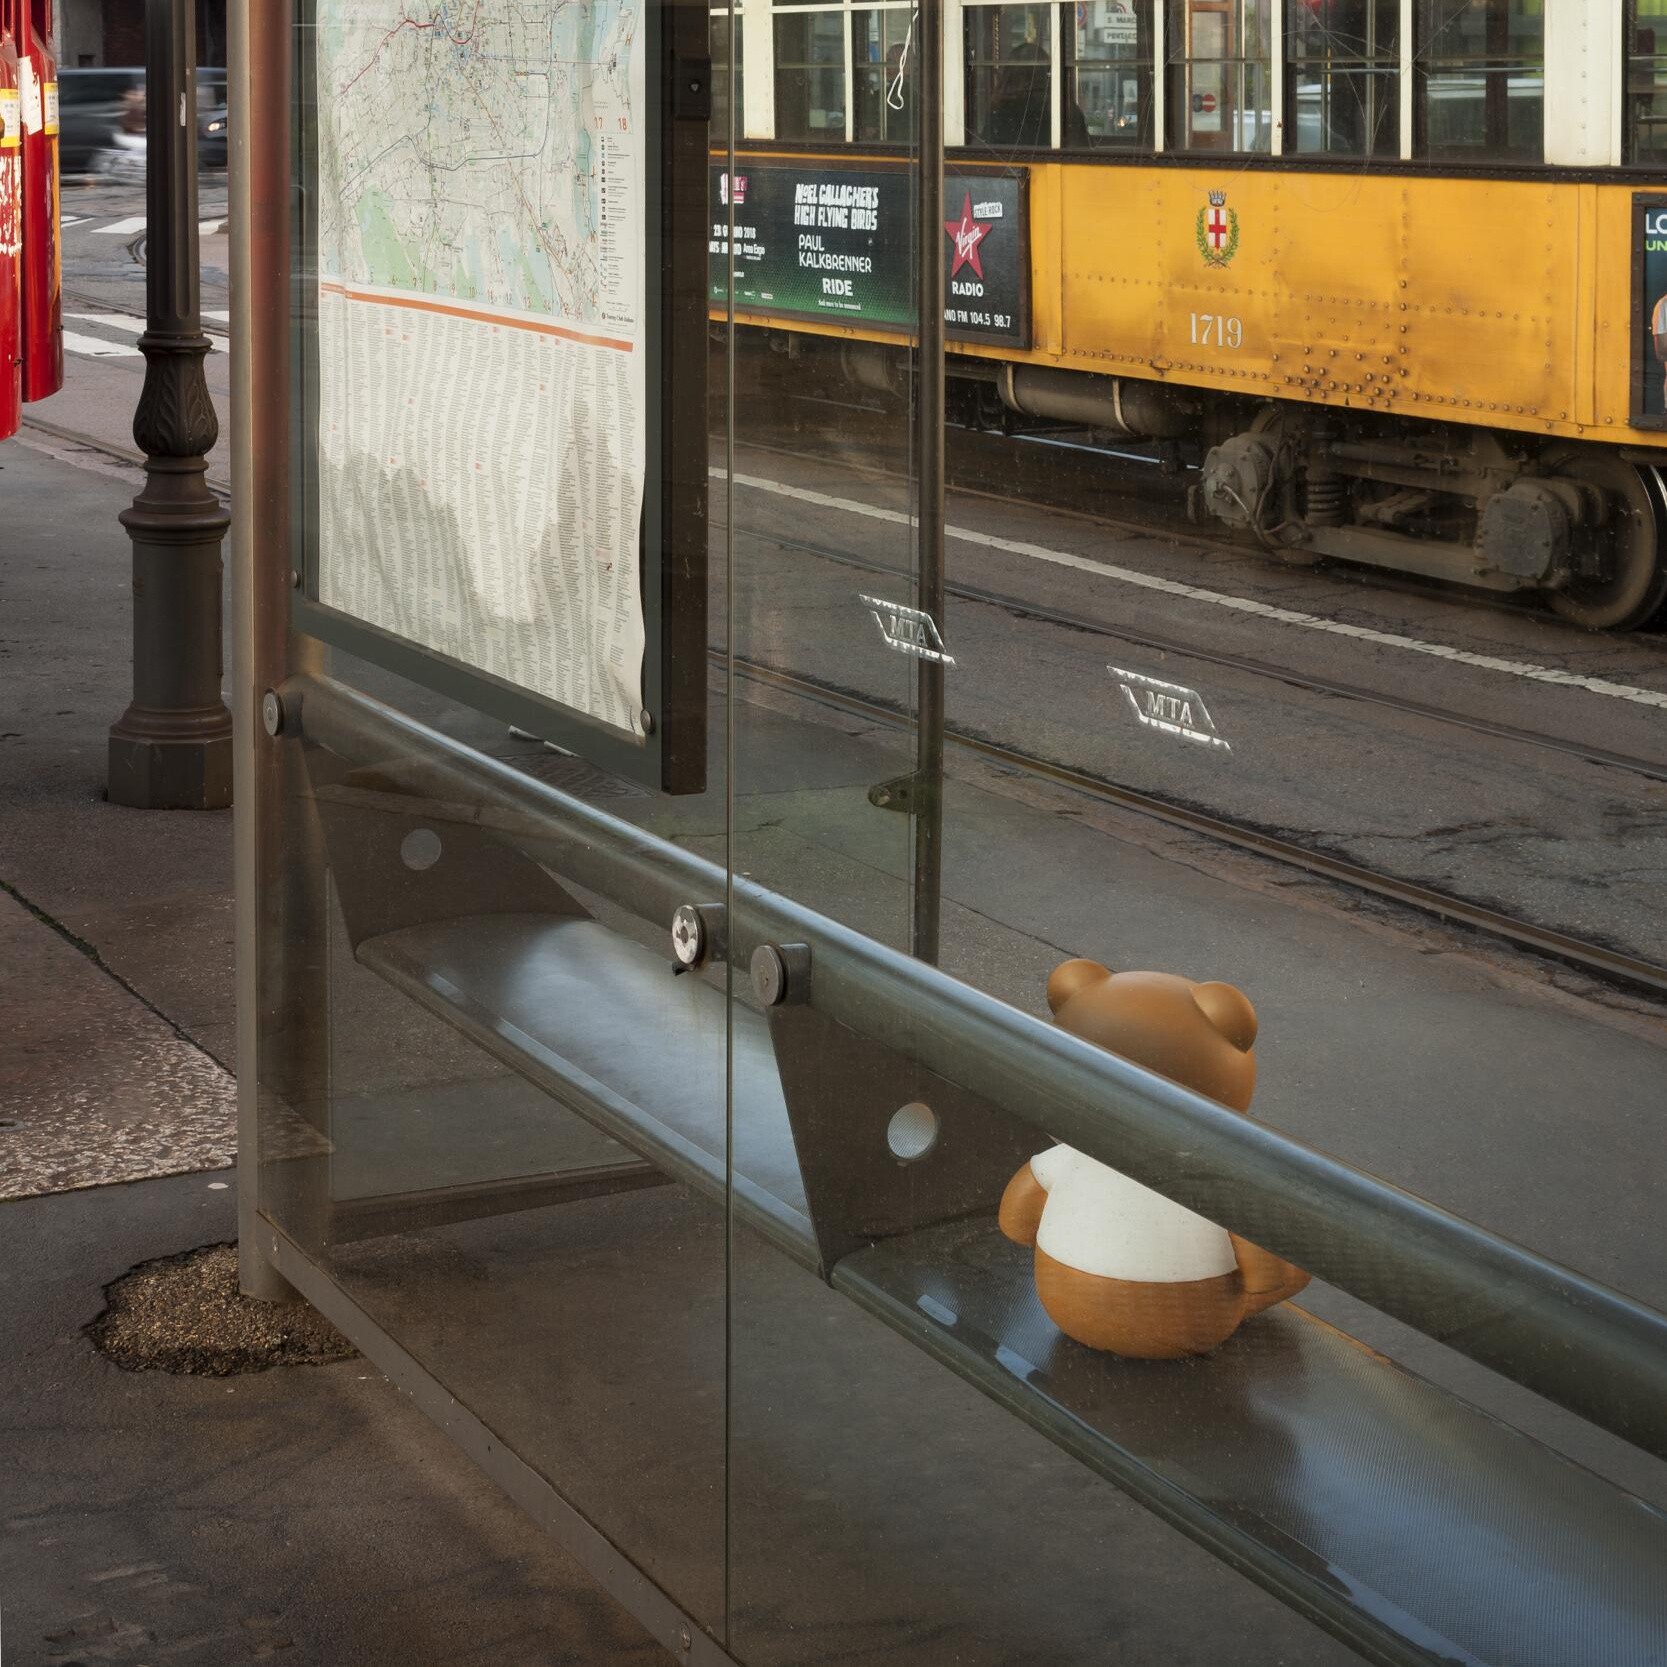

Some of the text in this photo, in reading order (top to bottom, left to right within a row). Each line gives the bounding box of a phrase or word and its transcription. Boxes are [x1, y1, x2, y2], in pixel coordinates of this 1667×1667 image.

[794, 204, 878, 231] HIGH FLYING BIRDS
[799, 233, 825, 251] PAUL
[799, 251, 872, 273] KALKBRENNER
[822, 278, 854, 297] RIDE
[952, 281, 984, 297] RADIO
[957, 310, 968, 324] FM
[970, 312, 991, 326] 104.5
[994, 314, 1011, 328] 98.7
[1190, 312, 1243, 349] 1719
